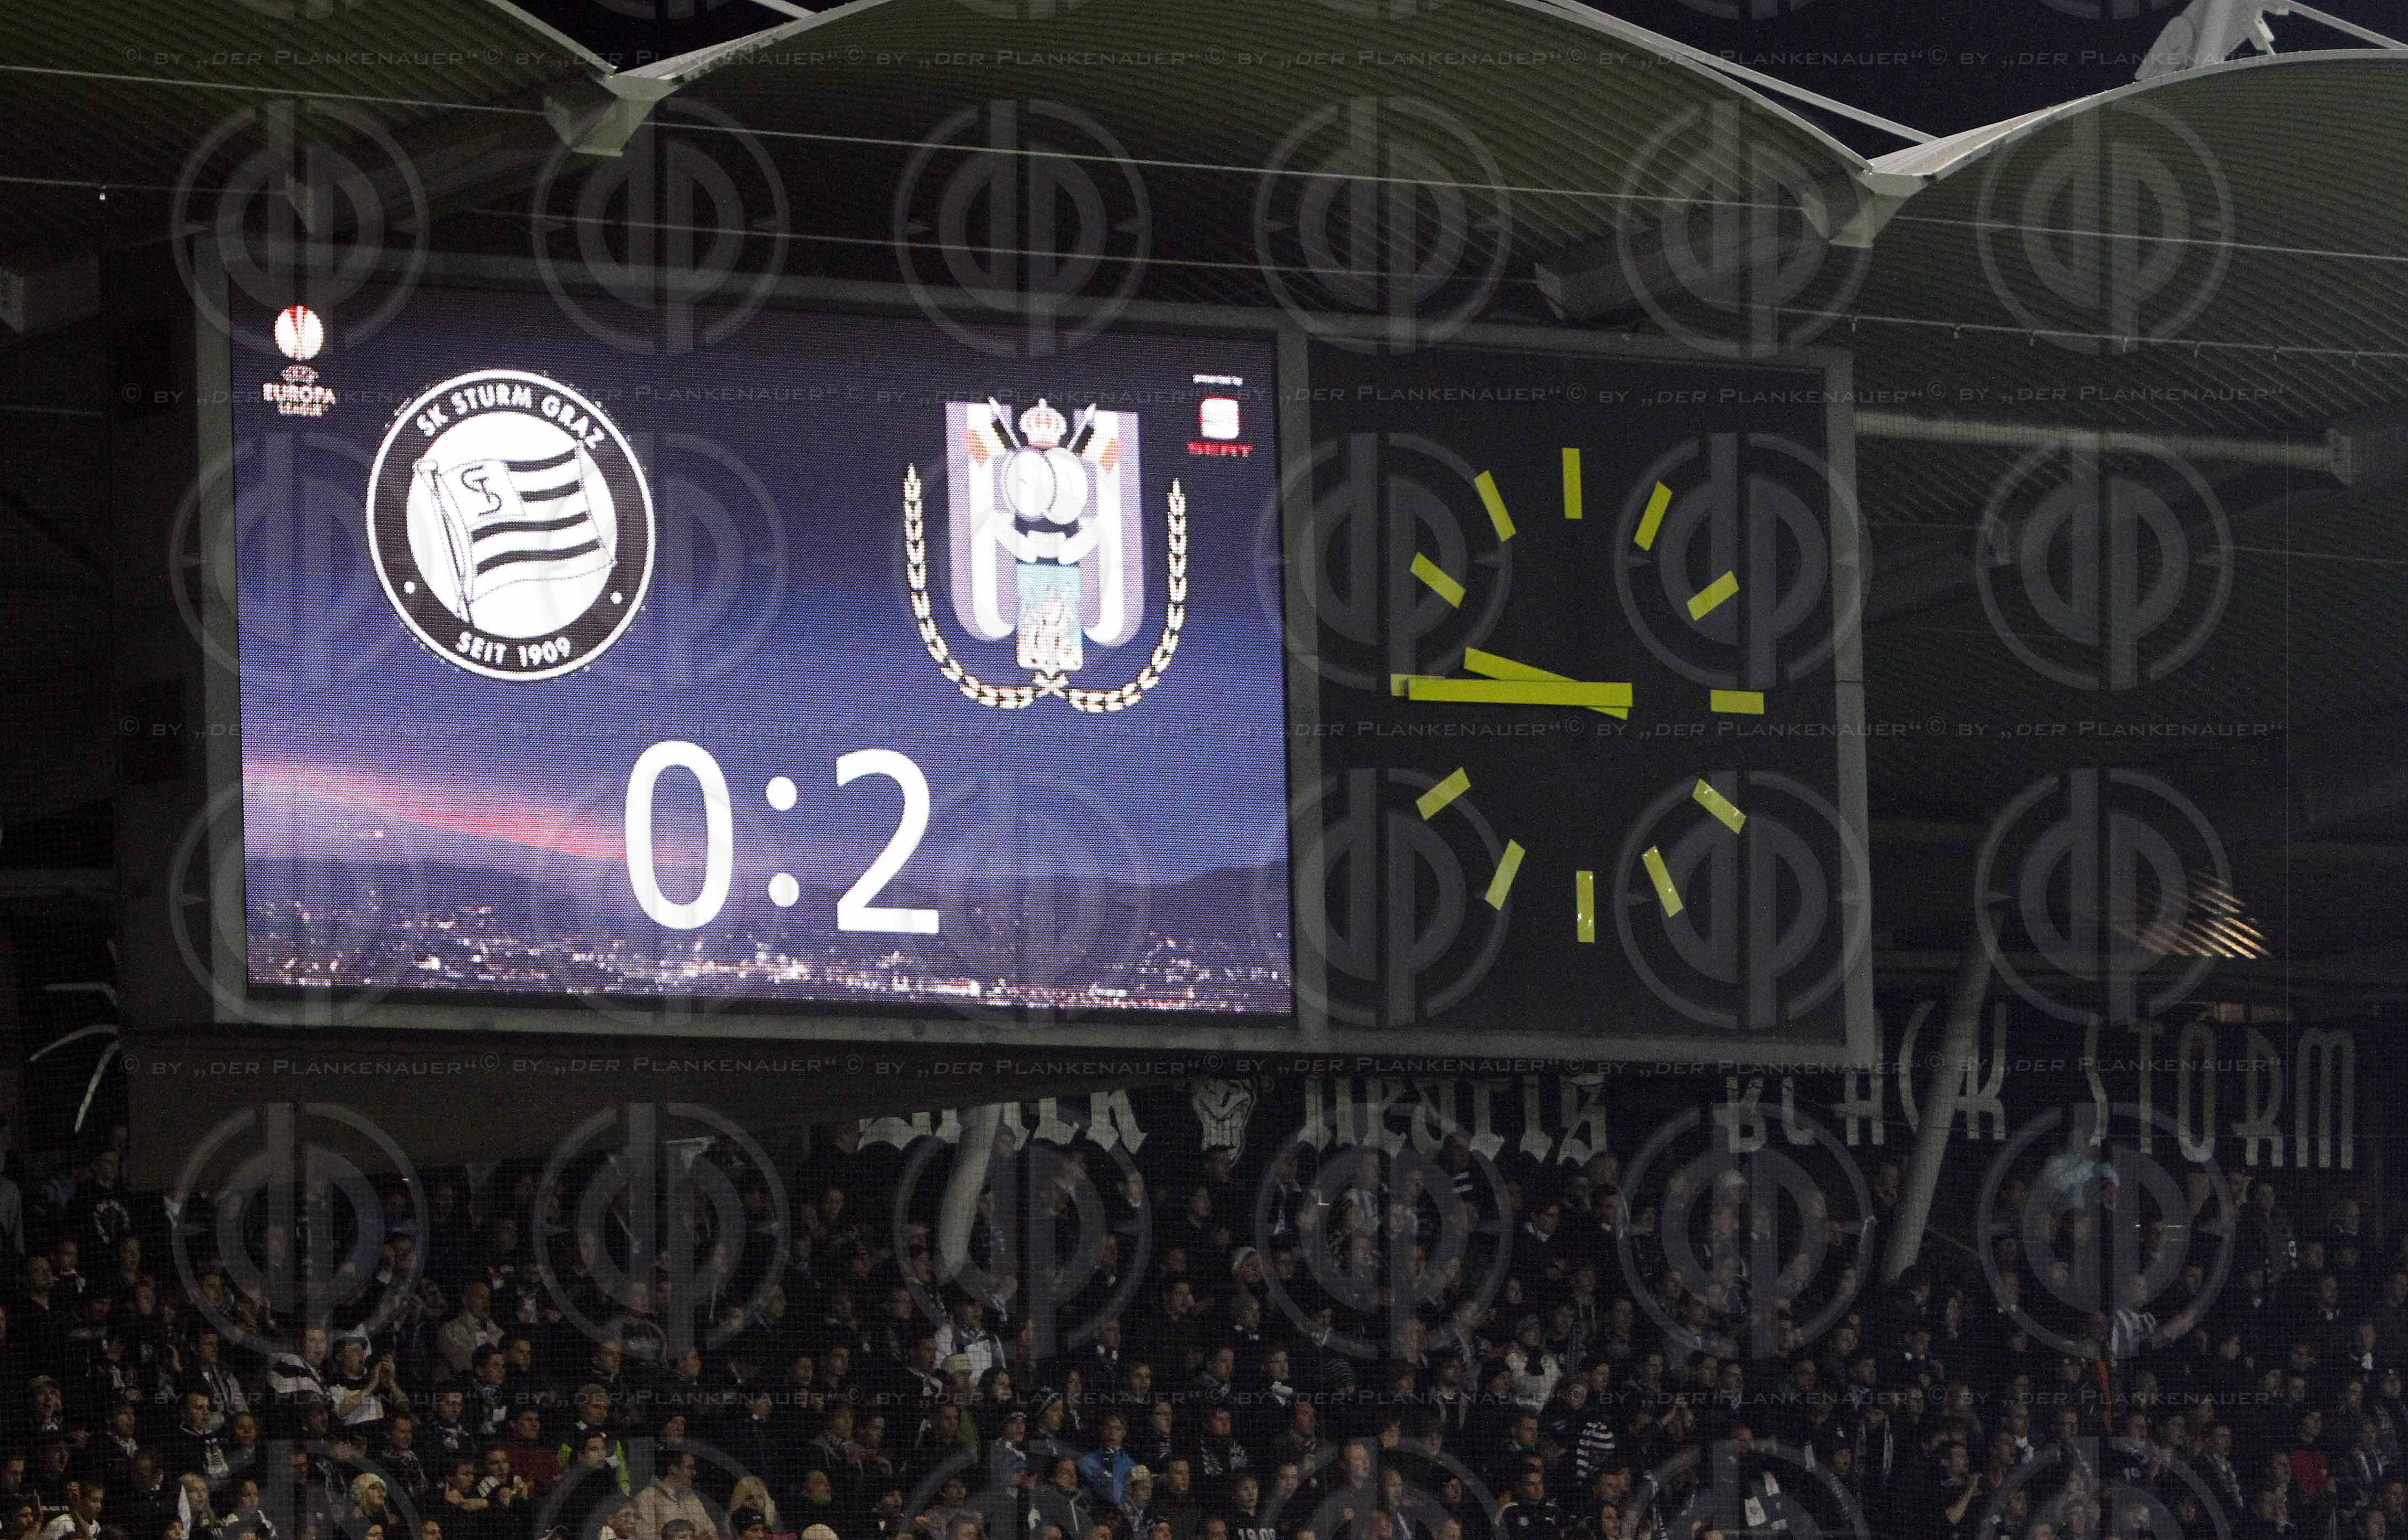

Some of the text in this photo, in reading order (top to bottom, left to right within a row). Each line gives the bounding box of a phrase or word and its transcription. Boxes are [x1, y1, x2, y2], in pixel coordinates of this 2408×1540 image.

[263, 383, 335, 405] EUROPA
[416, 403, 448, 437] SK
[451, 383, 532, 415] STURM
[542, 395, 605, 449] GRAZ
[455, 631, 570, 667] SEIT 1909
[625, 740, 939, 934] 0:2
